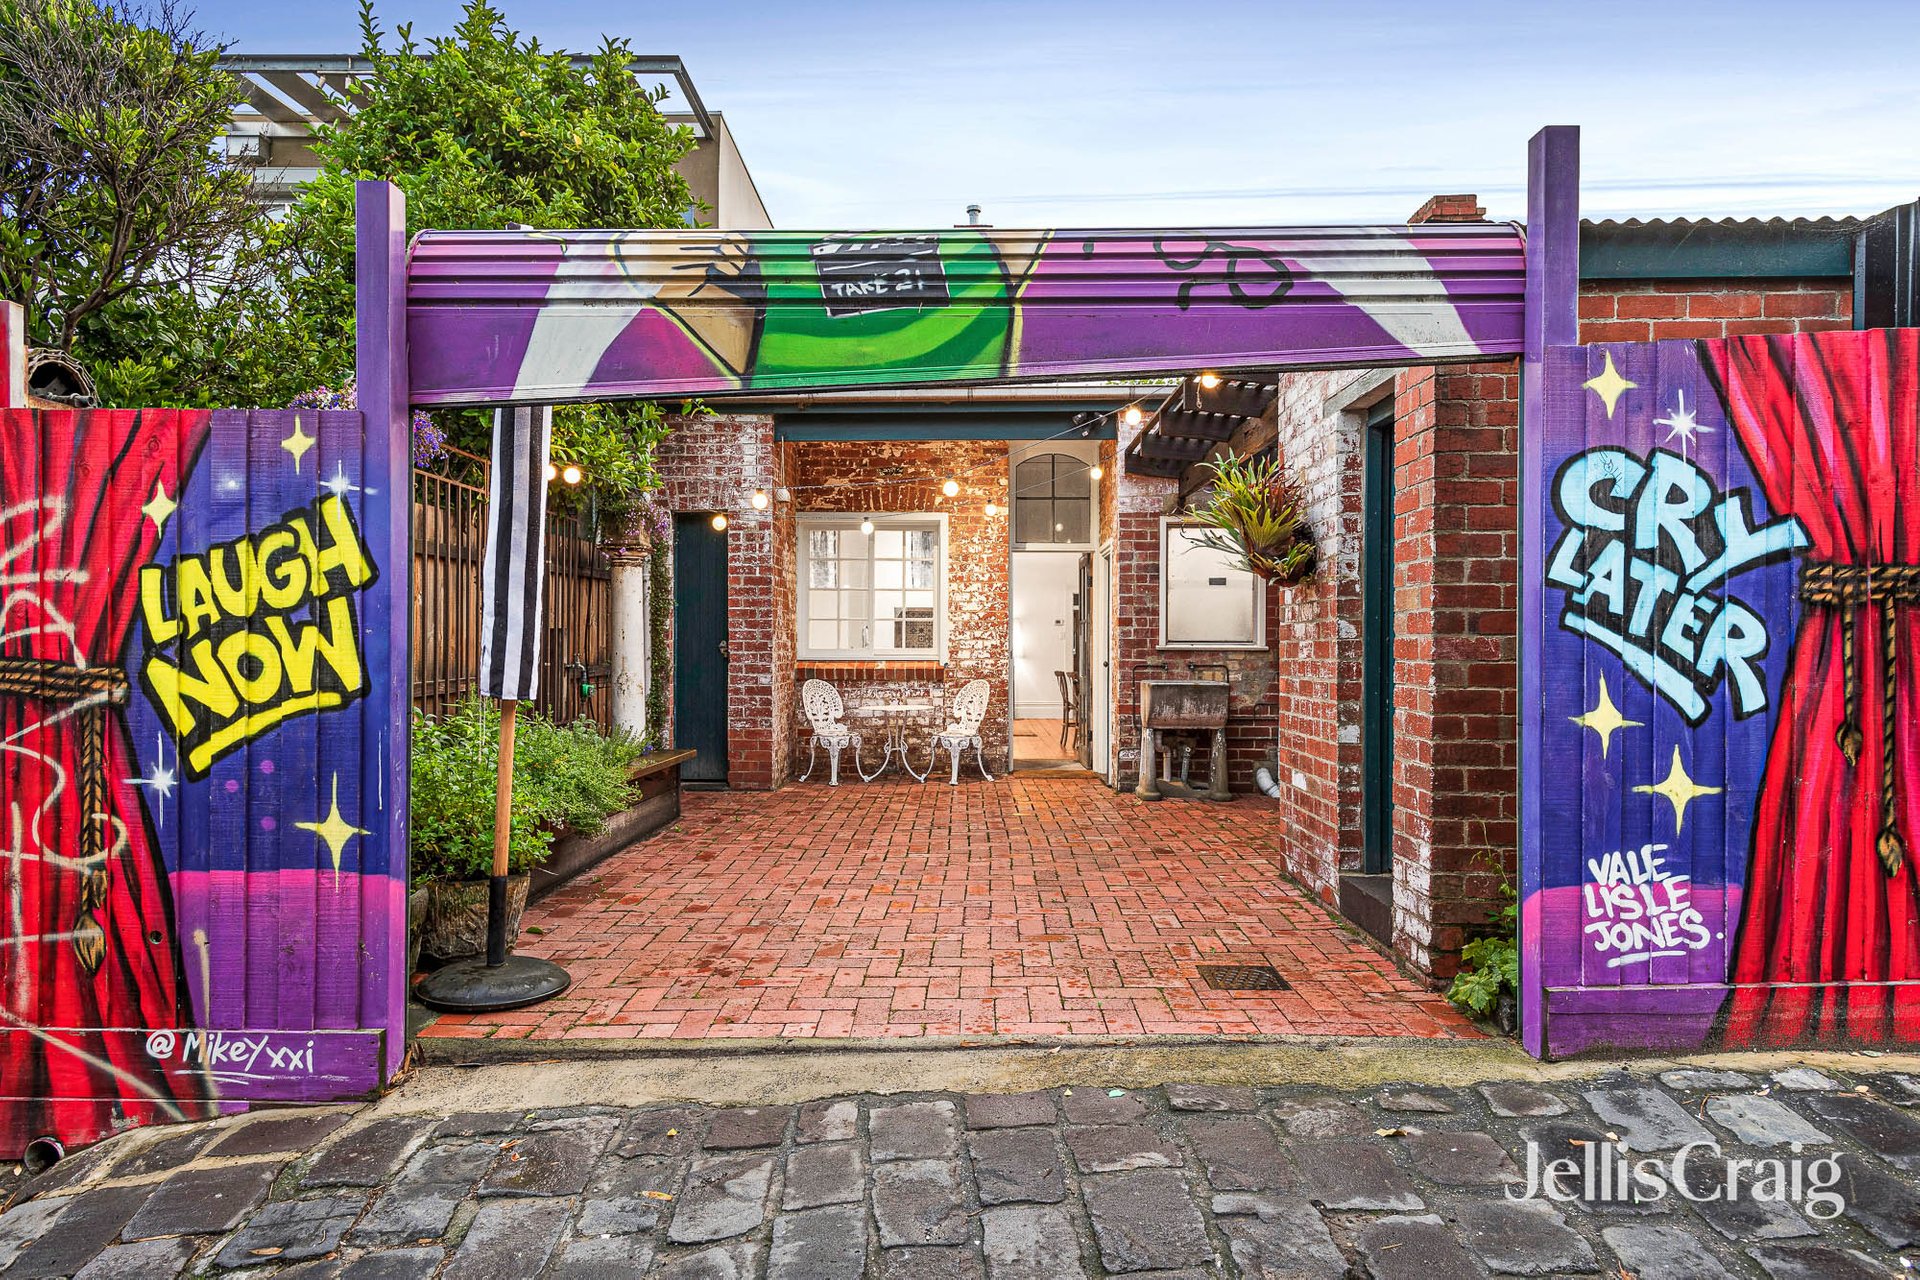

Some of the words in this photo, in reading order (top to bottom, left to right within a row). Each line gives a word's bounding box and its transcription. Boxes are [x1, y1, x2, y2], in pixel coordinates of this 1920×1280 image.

[140, 494, 375, 645] LAUGH
[1556, 448, 1811, 595] CRY
[145, 596, 365, 738] NOW
[1547, 527, 1768, 714] LATER
[1584, 874, 1691, 920] LISLE
[1587, 843, 1672, 888] VALE
